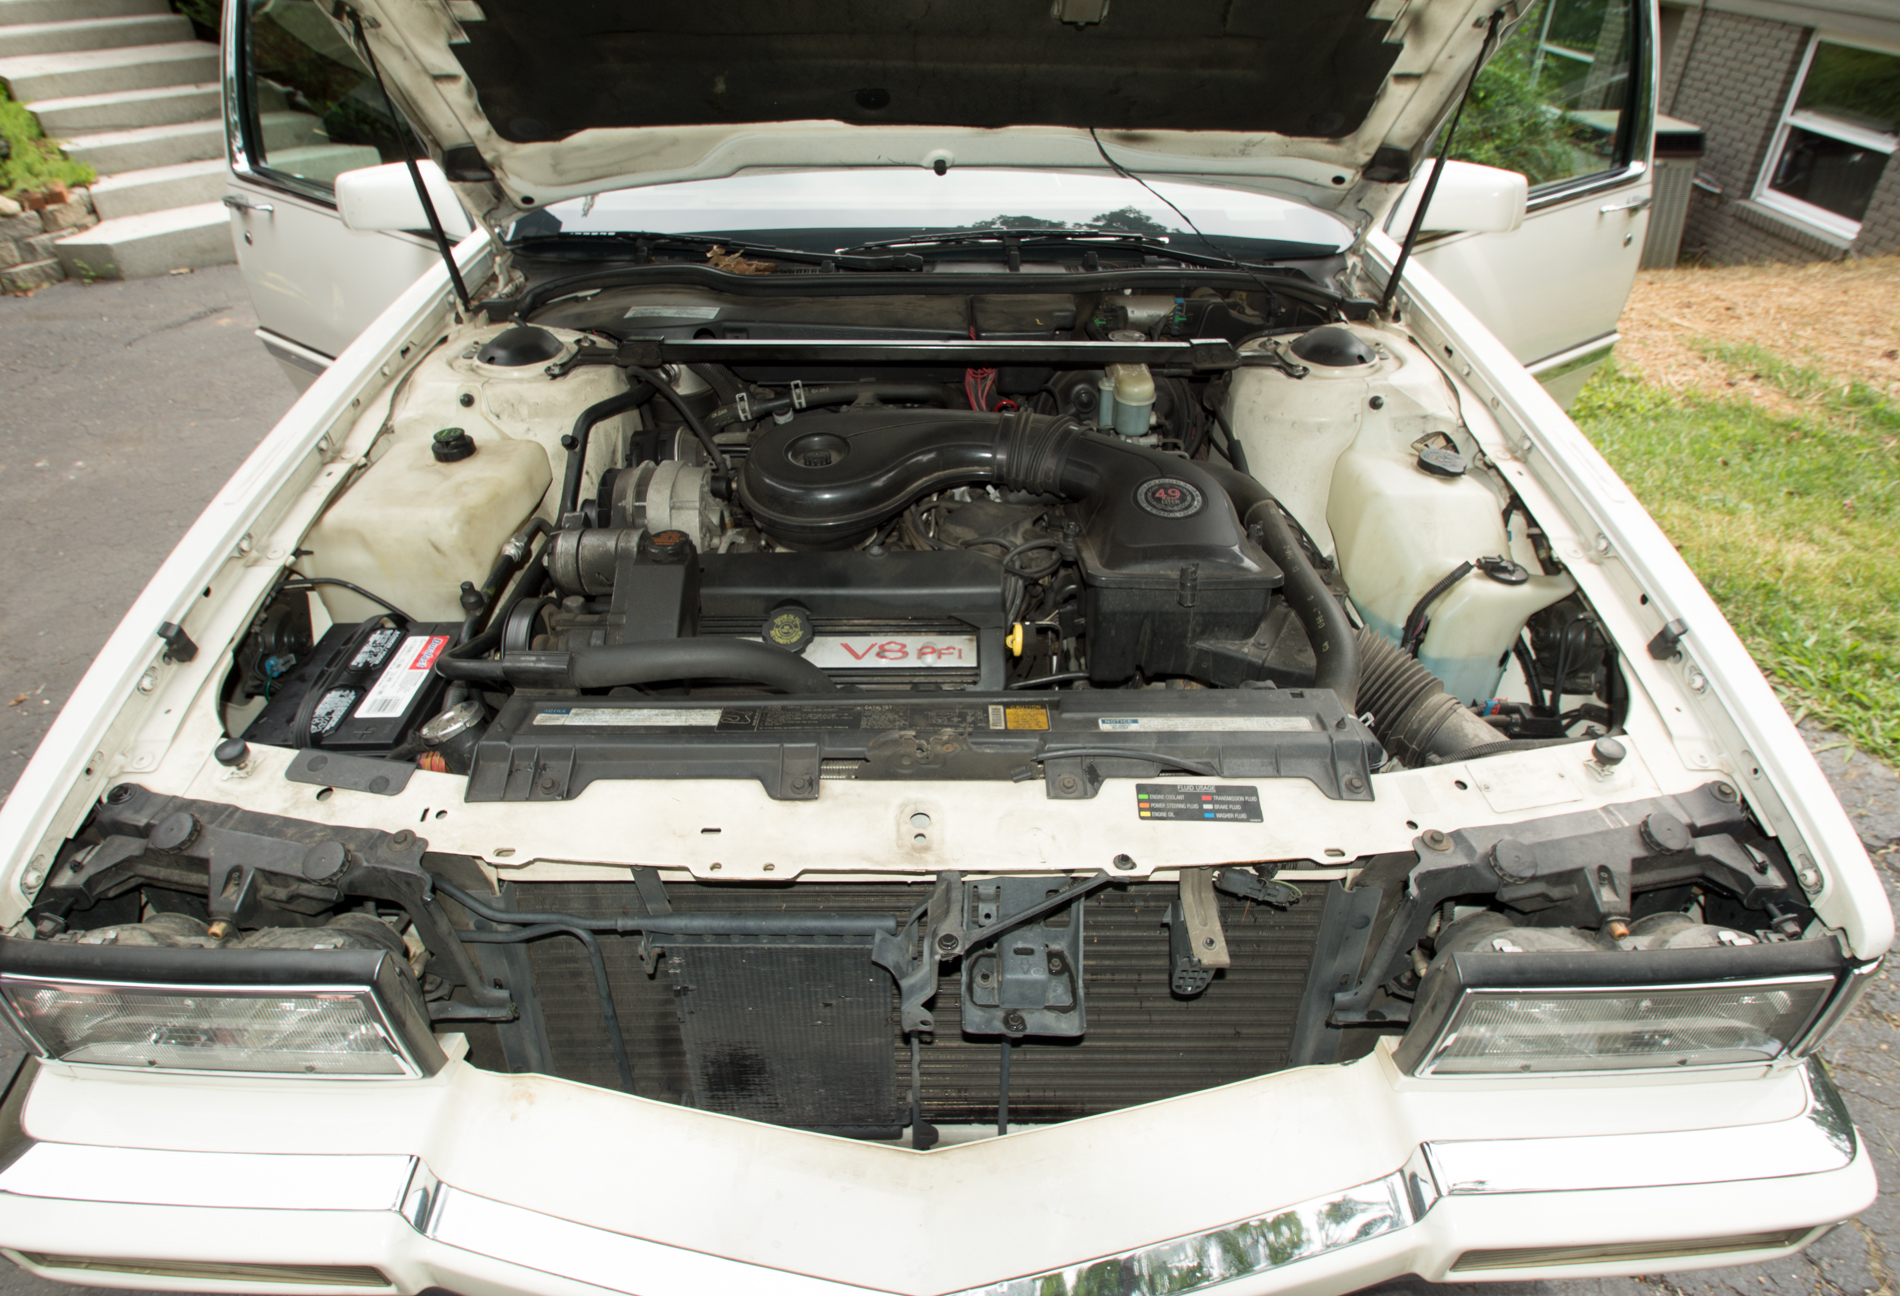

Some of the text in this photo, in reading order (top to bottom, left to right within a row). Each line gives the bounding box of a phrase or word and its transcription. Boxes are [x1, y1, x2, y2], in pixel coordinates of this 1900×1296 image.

[1155, 488, 1180, 499] 4.9
[416, 638, 443, 668] Duralast
[840, 641, 963, 660] V8 PFI
